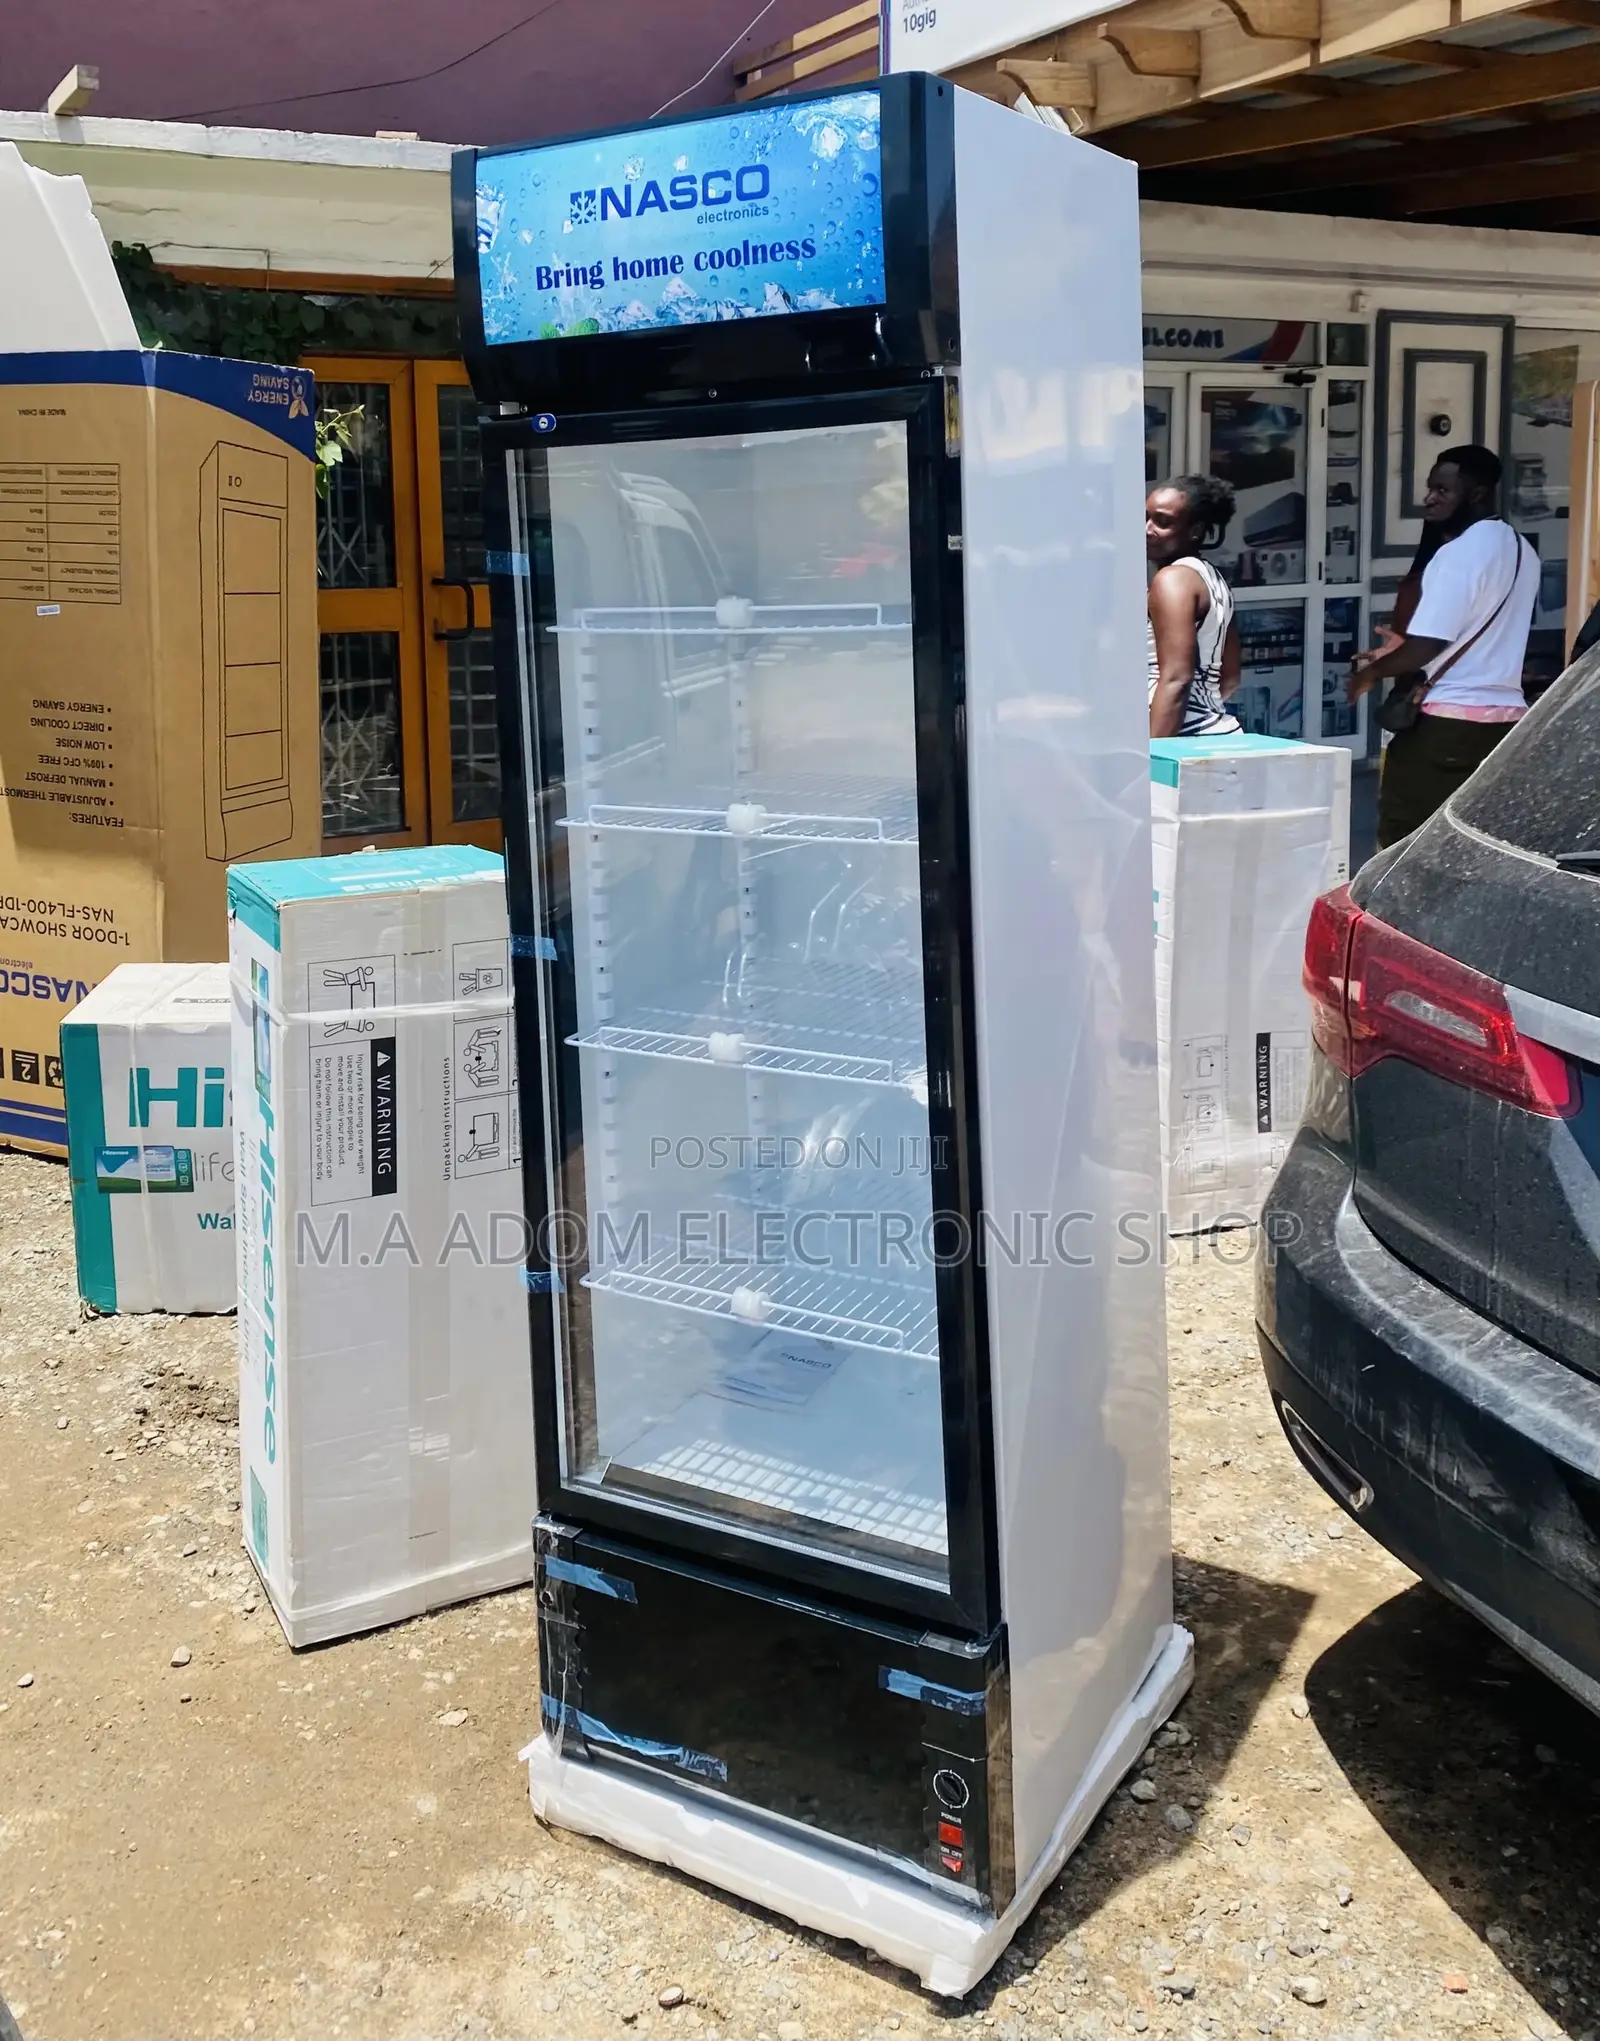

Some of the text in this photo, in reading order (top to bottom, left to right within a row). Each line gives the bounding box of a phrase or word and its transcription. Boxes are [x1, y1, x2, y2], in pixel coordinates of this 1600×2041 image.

[903, 7, 936, 33] 10gig
[601, 163, 770, 221] NASCO
[696, 203, 770, 225] electronics
[535, 237, 816, 291] Bring home coolness
[252, 373, 290, 390] SAVING
[247, 389, 289, 405] ENERGY
[32, 699, 104, 713] ENERGY SAVING
[30, 717, 105, 732] DIRECT COOLING
[55, 737, 105, 750] LOW NOISE
[38, 754, 105, 769] 100% CFC FREE
[25, 772, 106, 788] MANUAL DEFROST
[49, 791, 106, 806] ADJUSTABLE
[69, 812, 124, 828] FEATURES:
[72, 925, 130, 946] 1-DOOR
[314, 1058, 322, 1078] bring
[324, 1057, 332, 1068] Do
[356, 1053, 365, 1076] Injury
[20, 1063, 31, 1081] 2
[1259, 1045, 1268, 1110] WARNING
[315, 1080, 323, 1099] harm
[347, 1086, 353, 1094] or
[357, 1077, 365, 1092] risk
[129, 1067, 233, 1127] Hi
[357, 1093, 365, 1104] for
[314, 1111, 323, 1133] injury
[336, 1118, 344, 1134] your
[356, 1106, 365, 1128] being
[377, 1074, 392, 1175] WARNING
[346, 1116, 354, 1141] people
[316, 1134, 323, 1142] to
[325, 1123, 333, 1164] instruction
[347, 1143, 354, 1151] to
[314, 1144, 323, 1160] your
[337, 1137, 345, 1168] product.
[315, 1162, 324, 1180] body
[258, 1094, 276, 1464] Hisense
[941, 1811, 962, 1824] POWER
